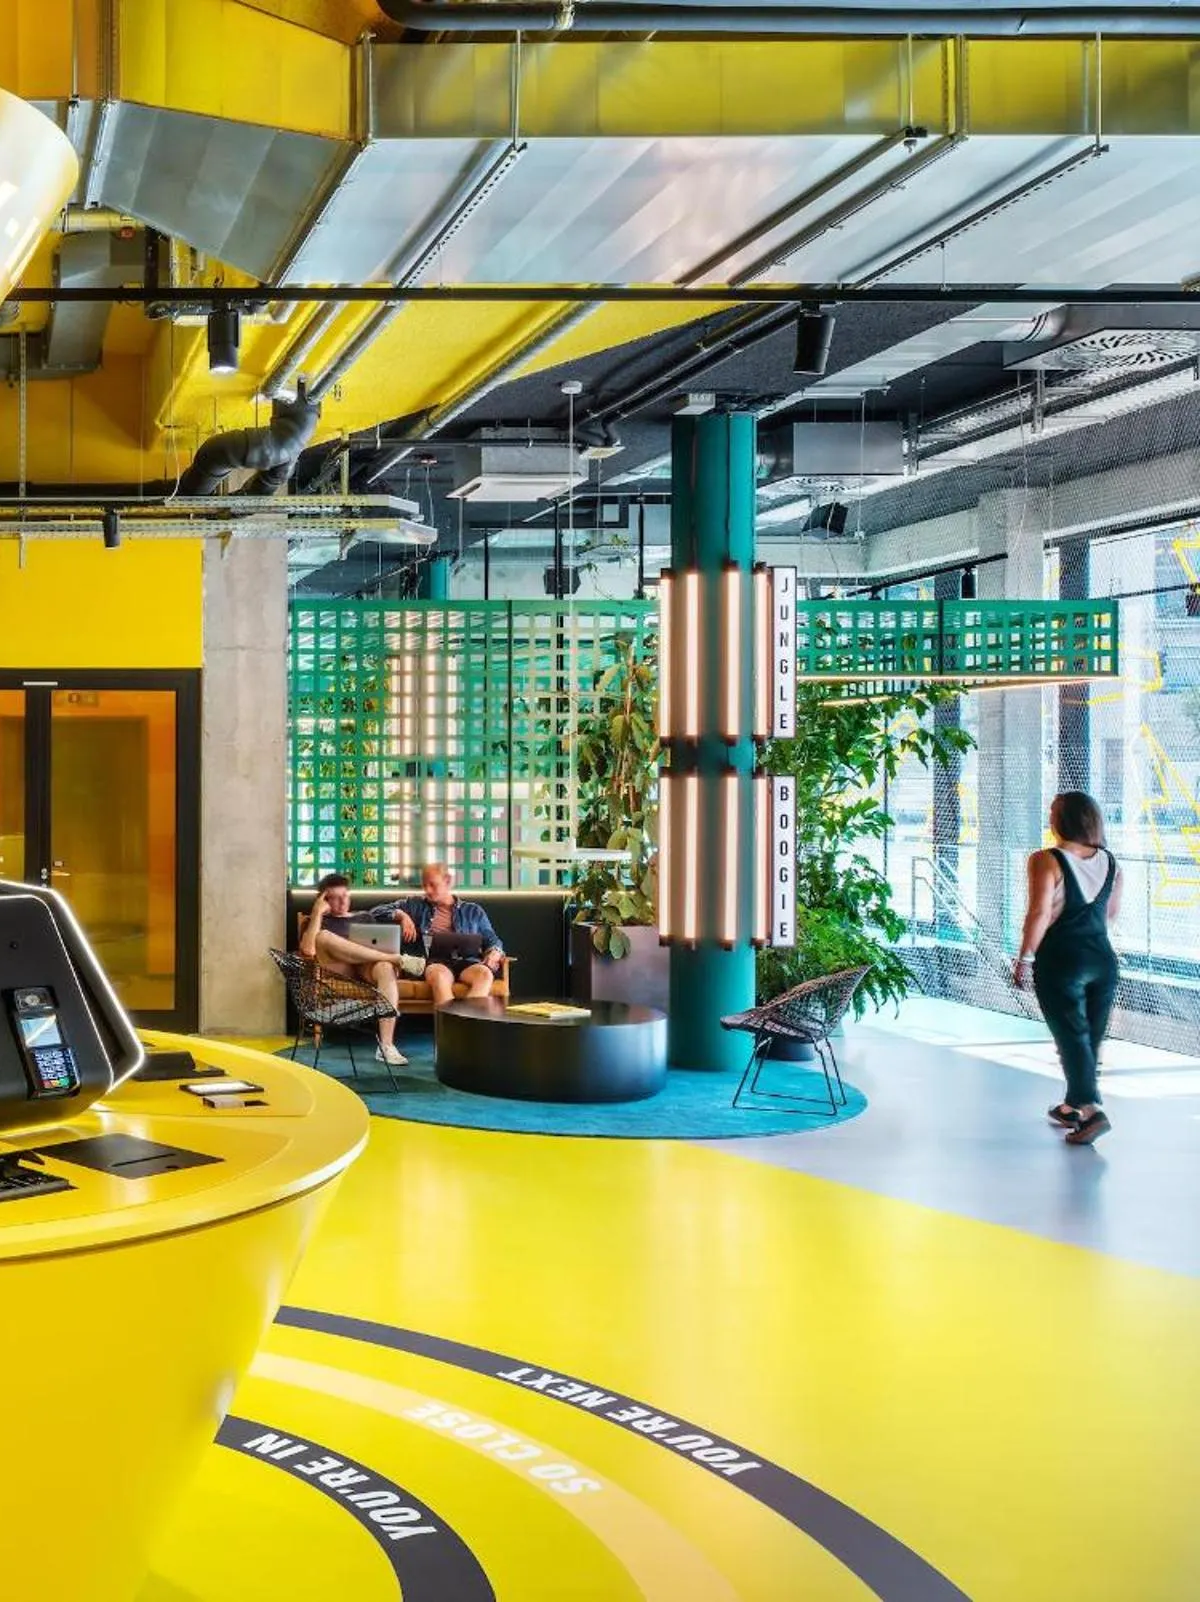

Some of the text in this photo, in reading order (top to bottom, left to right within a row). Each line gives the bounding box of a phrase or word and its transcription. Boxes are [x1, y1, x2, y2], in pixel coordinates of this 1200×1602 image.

[779, 577, 790, 730] JUNGLE
[779, 785, 789, 939] BOOGIE
[403, 1402, 604, 1495] SO CLOSE
[496, 1368, 763, 1477] YOU'RE NEXT
[243, 1433, 437, 1540] YOU'RE IN
